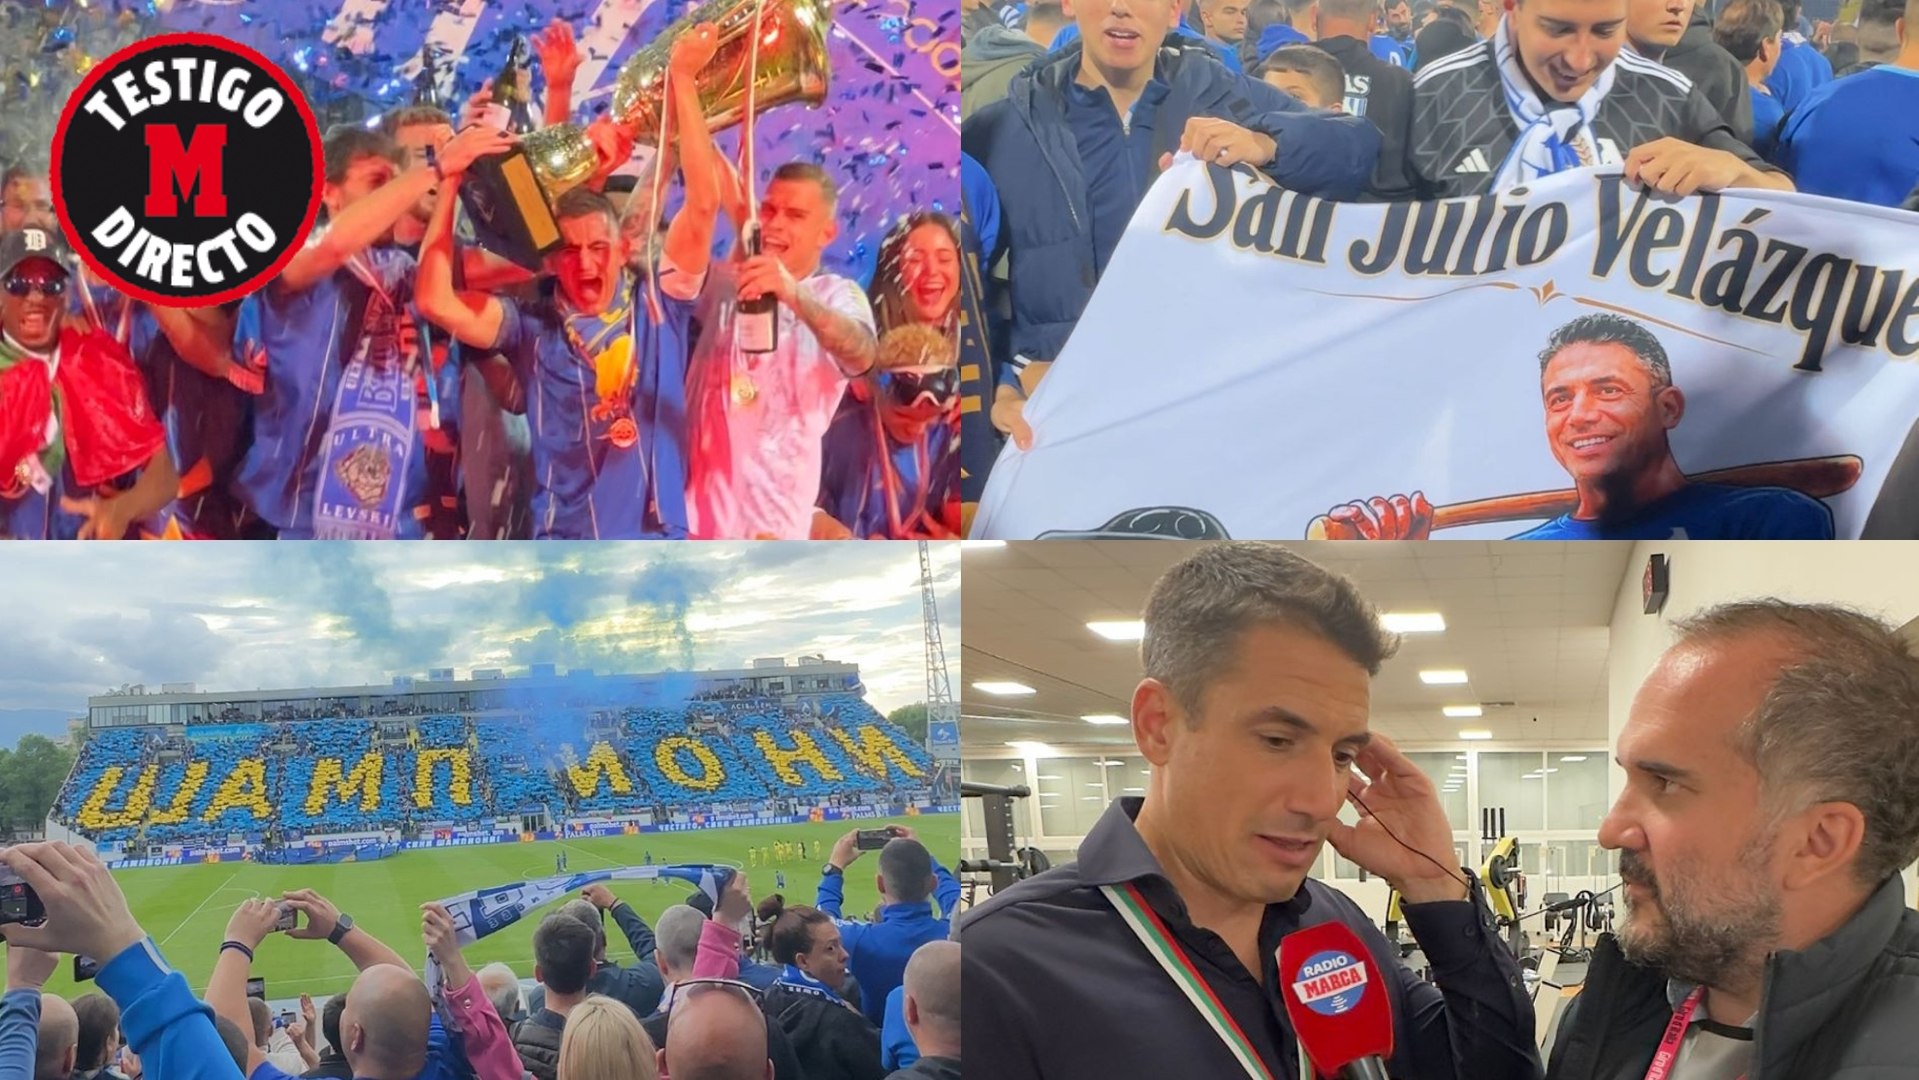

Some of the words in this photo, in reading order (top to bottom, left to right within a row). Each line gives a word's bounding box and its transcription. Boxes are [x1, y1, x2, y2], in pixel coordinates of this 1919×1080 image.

[1164, 160, 1337, 264] San
[1348, 186, 1569, 276] Julio
[23, 229, 47, 251] D
[333, 426, 404, 458] ULTRA
[321, 502, 391, 528] LEVSKI
[1302, 954, 1349, 978] RADIO
[1302, 967, 1362, 1000] MARCA
